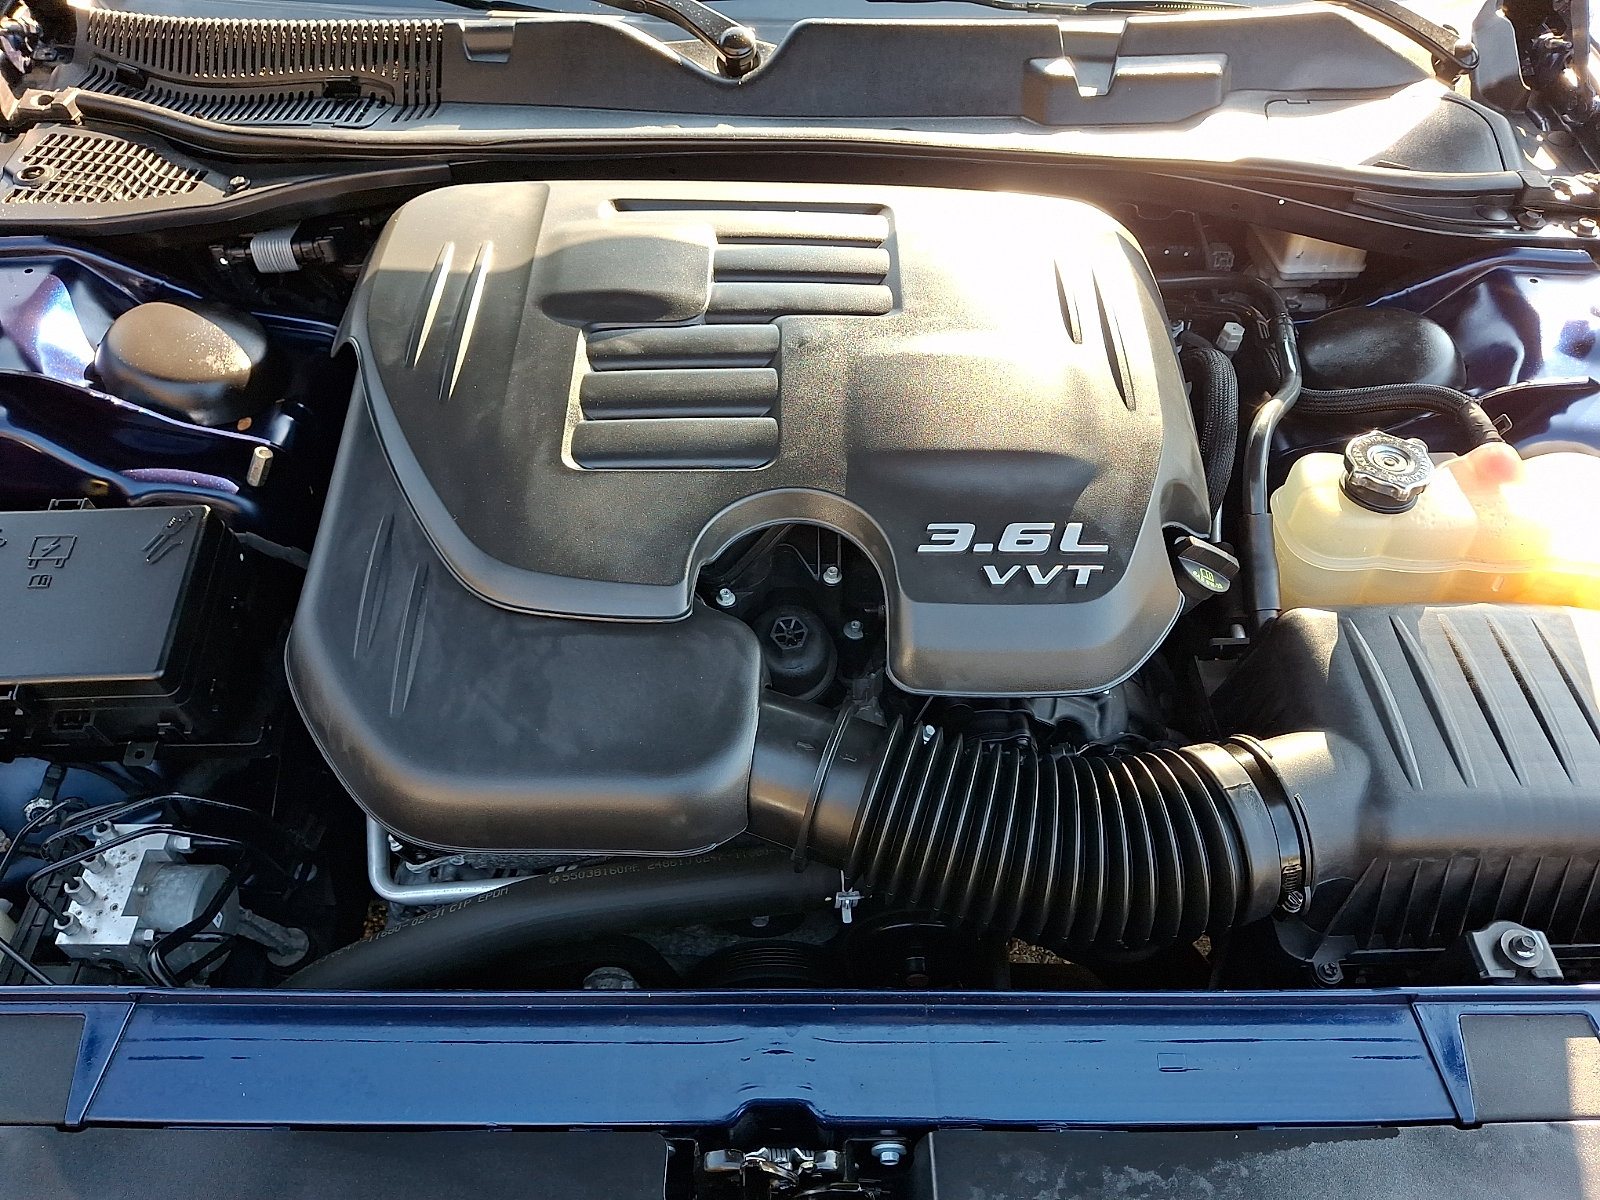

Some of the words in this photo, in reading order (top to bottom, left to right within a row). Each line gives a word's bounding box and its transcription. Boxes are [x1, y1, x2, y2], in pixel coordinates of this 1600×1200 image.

[917, 521, 1109, 555] 3.6L
[982, 563, 1104, 588] VVT
[477, 887, 509, 904] EPDM
